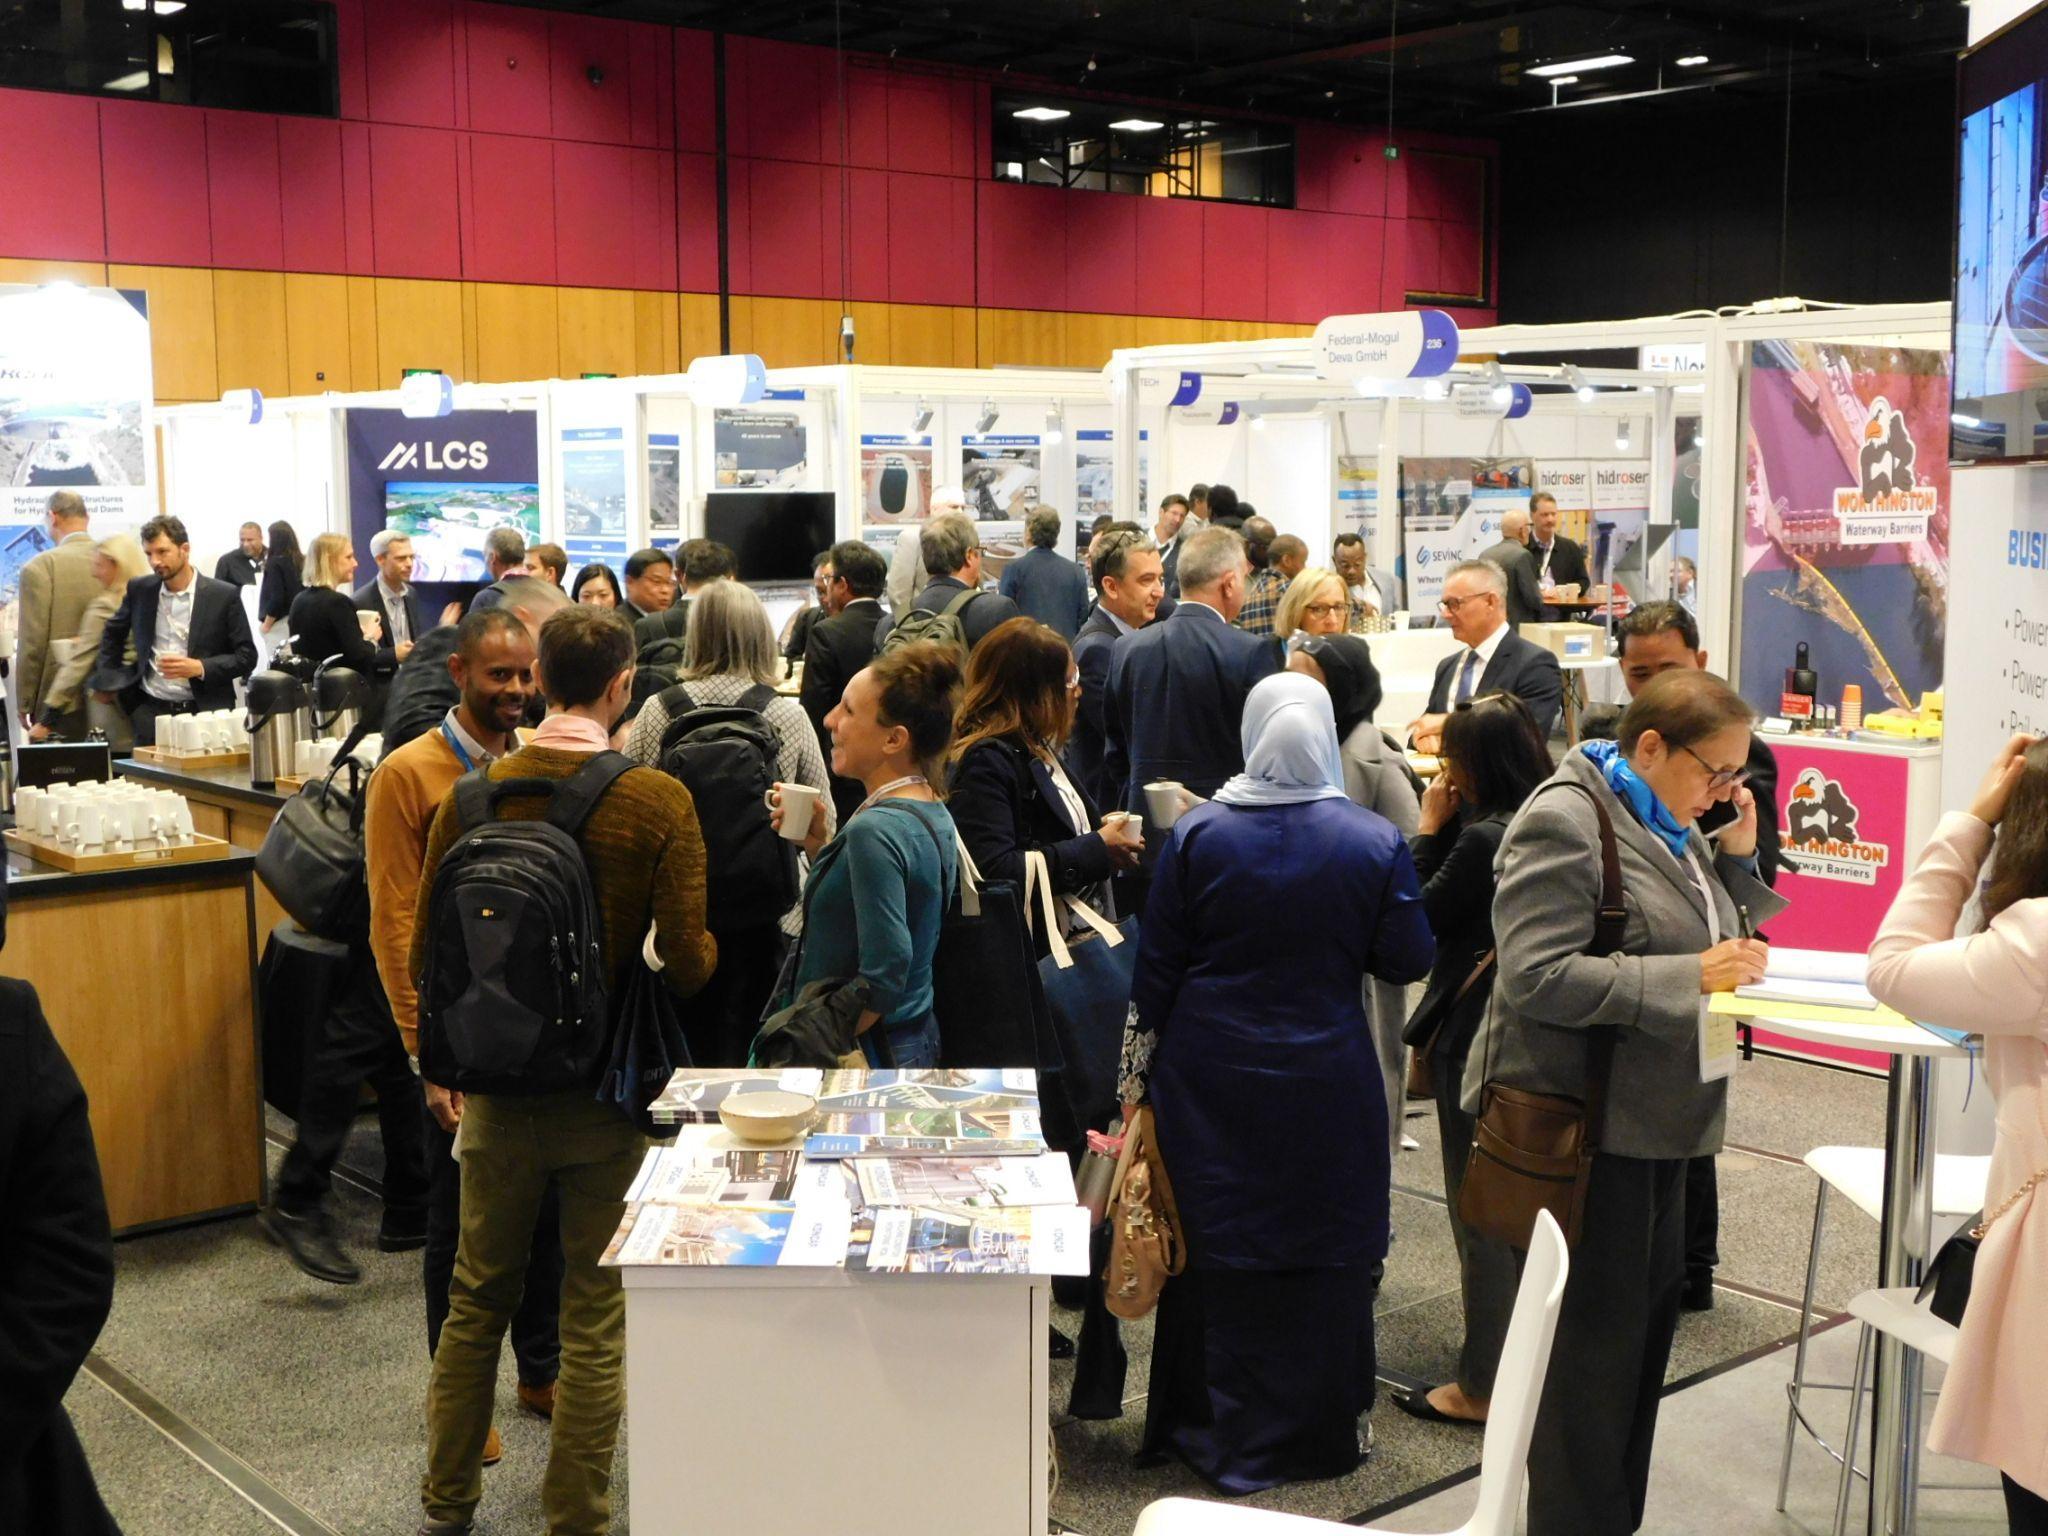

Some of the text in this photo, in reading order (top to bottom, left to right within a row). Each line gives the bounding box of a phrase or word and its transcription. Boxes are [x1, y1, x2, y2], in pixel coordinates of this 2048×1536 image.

[1328, 331, 1400, 346] Federal-Mogul
[1426, 338, 1442, 349] 236
[1328, 350, 1388, 363] Deva GmbH
[425, 440, 489, 470] LCS
[1541, 470, 1586, 486] hidroser
[1597, 470, 1649, 485] hidroser
[13, 496, 47, 507] Hydraul
[1837, 491, 1934, 513] WORHINGTON
[1845, 522, 1923, 538] Waterway Barriers
[2007, 529, 2048, 571] BUSI
[1417, 576, 1443, 585] Where
[2013, 608, 2048, 648] Power
[2011, 659, 2048, 700] Power
[1826, 863, 1870, 879] Barriers
